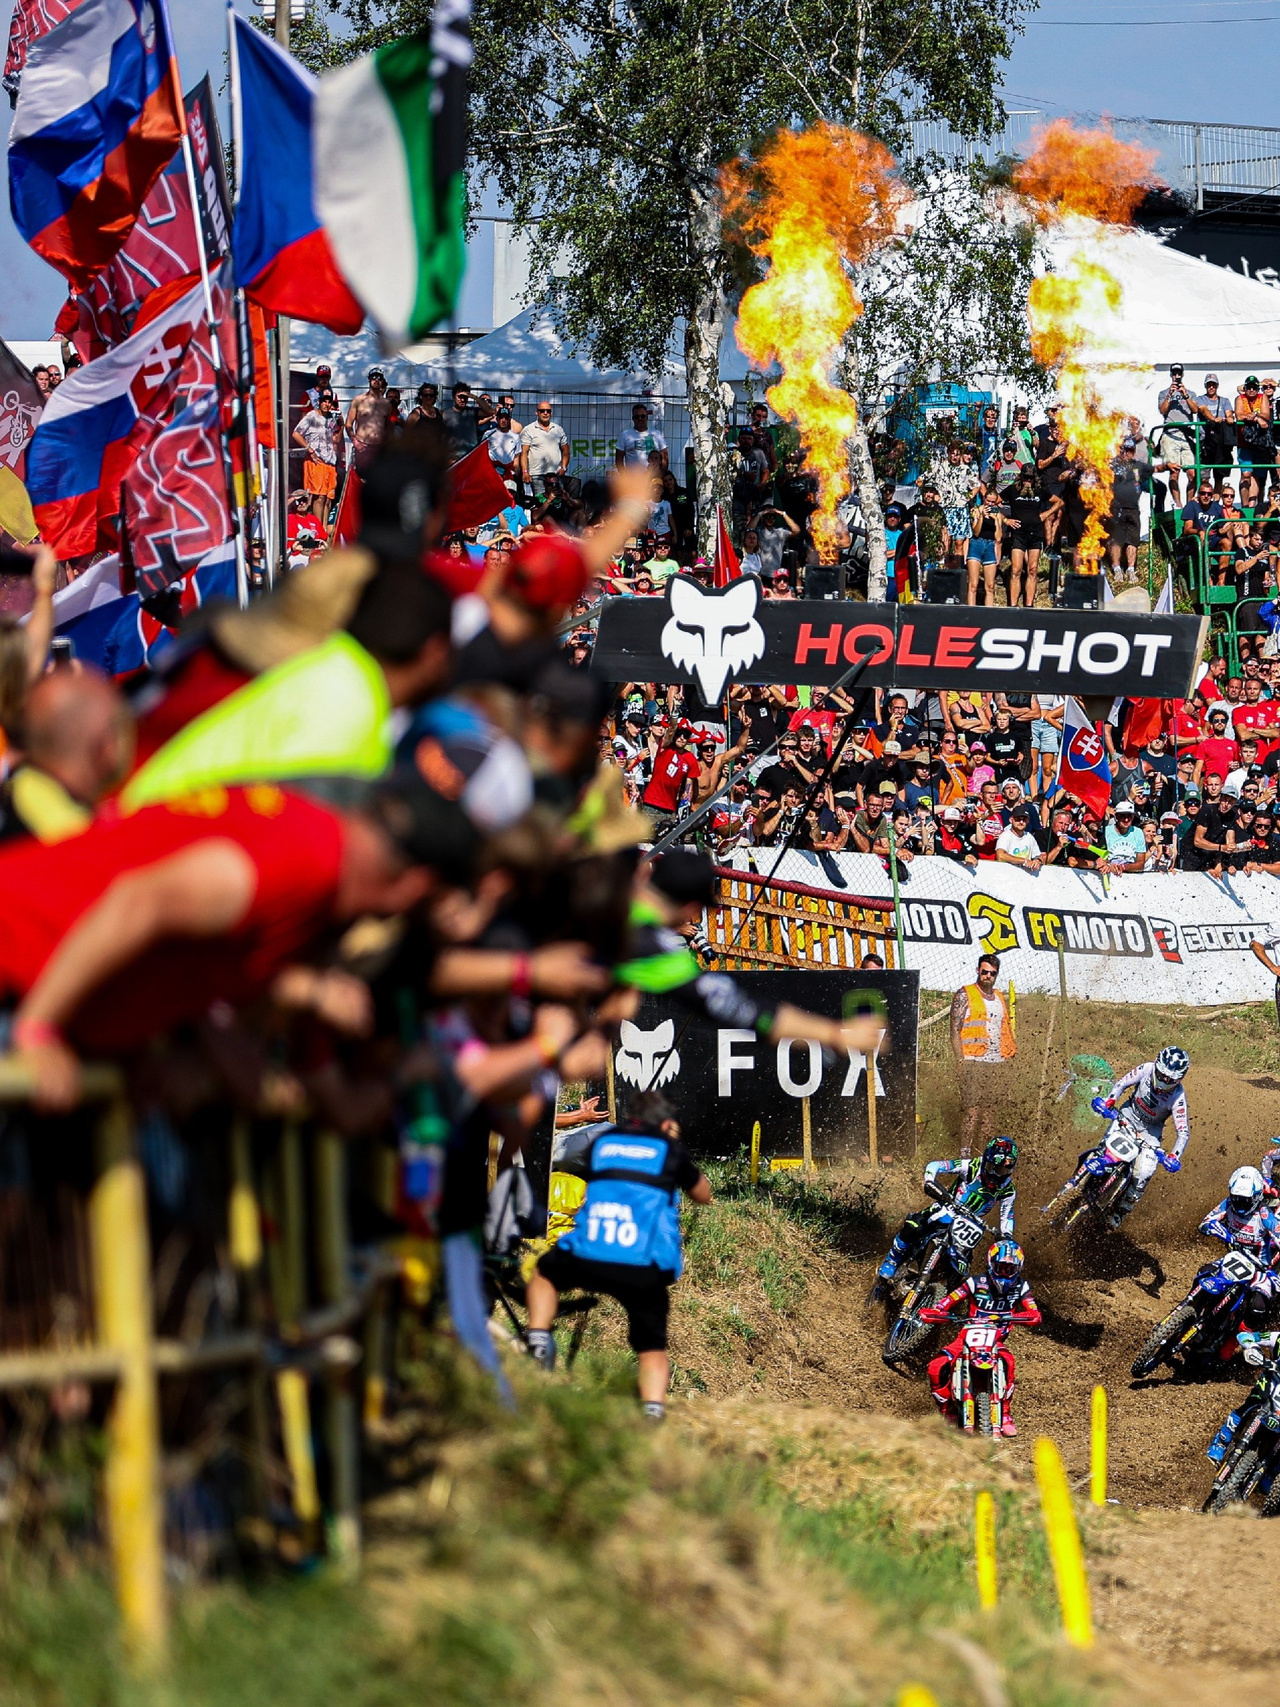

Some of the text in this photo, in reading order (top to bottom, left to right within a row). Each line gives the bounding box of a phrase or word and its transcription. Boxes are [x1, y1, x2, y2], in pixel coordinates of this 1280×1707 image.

[794, 623, 1173, 677] HOLESHOT
[1028, 911, 1146, 954] FC MOTO
[717, 1028, 887, 1098] FOX
[1110, 1135, 1131, 1155] 6
[587, 1218, 639, 1248] 110
[952, 1219, 982, 1247] 259
[1222, 1256, 1253, 1280] 10
[965, 1328, 997, 1348] 61
